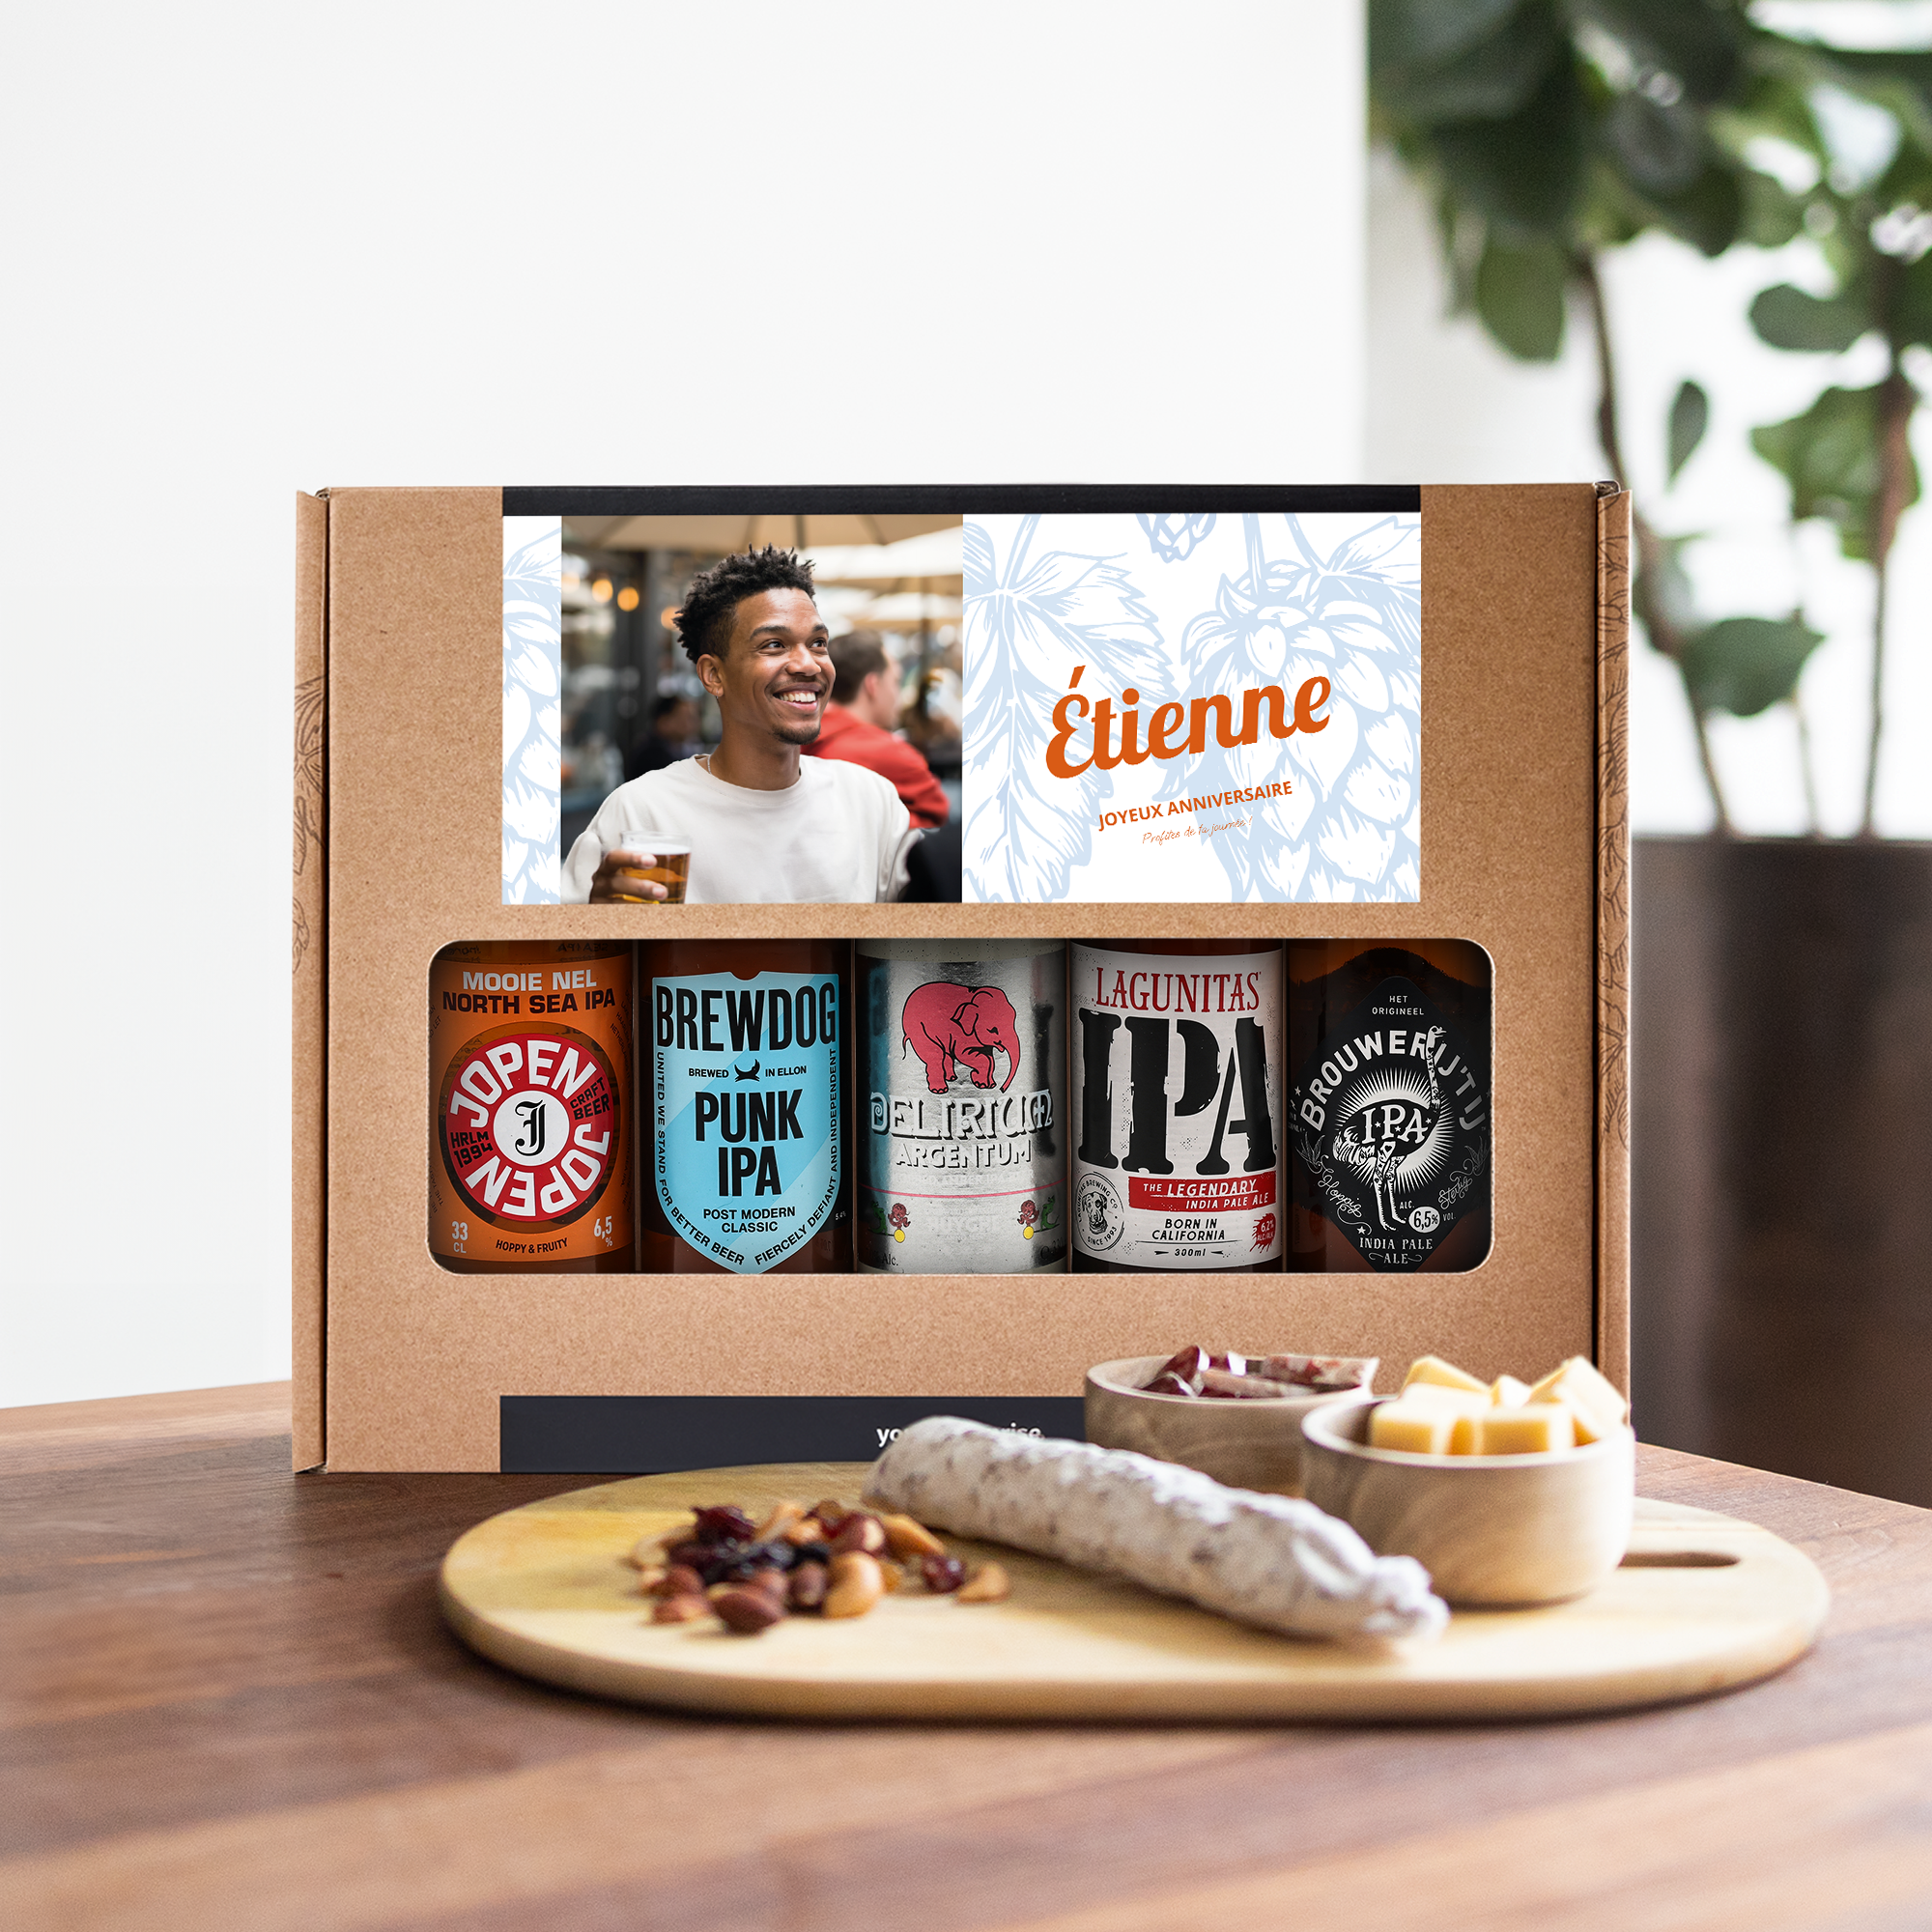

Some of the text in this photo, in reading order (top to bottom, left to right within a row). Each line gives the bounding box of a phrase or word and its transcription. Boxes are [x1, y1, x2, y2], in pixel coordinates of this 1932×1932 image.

[1046, 665, 1331, 779] Étienne
[1098, 781, 1293, 832] JOYEUX ANNIVERSAIRE
[1184, 826, 1196, 837] de
[462, 969, 597, 992] MOOIE NEL
[1095, 967, 1261, 1013] LAGUNITAS
[442, 991, 521, 1014] NORTH
[529, 993, 579, 1013] SEA
[585, 987, 616, 1010] IPA
[1389, 995, 1407, 1004] HET
[656, 981, 837, 1052] BREWDOG
[1372, 1007, 1424, 1016] ORIGINEEL
[689, 1065, 807, 1078] BREWED IN ELLON
[450, 1039, 597, 1128] JOPEN
[570, 1077, 606, 1108] CRAFT
[1078, 1007, 1278, 1176] IPA
[574, 1094, 611, 1121] BEER
[695, 1089, 804, 1143] PUNK
[870, 1089, 1054, 1141] DELIRIUM
[1362, 1104, 1429, 1146] IPA
[450, 1130, 490, 1149] HRLM
[453, 1143, 494, 1168] 1994
[656, 1052, 745, 1265] UNITED WE STAND FOR BETTER BEER
[754, 1228, 808, 1265] FIERCELY
[807, 1178, 838, 1227] DEFIANT
[829, 1048, 838, 1141] INDEPENDENT
[895, 1140, 1033, 1168] ARGENTUM
[465, 1122, 611, 1216] JOPEN
[718, 1146, 781, 1197] IPA
[1143, 1178, 1258, 1197] THE LEGENDARY
[1318, 1168, 1362, 1218] Hoppig
[1185, 1192, 1268, 1209] INDIA PALE ALE
[1399, 1201, 1415, 1209] ALC.
[703, 1206, 796, 1220] POST MODERN
[1413, 1209, 1438, 1229] 6,5%
[1442, 1212, 1457, 1222] VOL.
[451, 1221, 469, 1240] 33
[593, 1216, 612, 1238] 6,5
[721, 1220, 779, 1233] CLASSIC
[1164, 1218, 1217, 1230] BORN IN
[496, 1237, 568, 1254] HOPPY & FRUITY
[1088, 1236, 1103, 1246] SINCE
[1151, 1230, 1226, 1241] CALIFORNIA
[1359, 1236, 1433, 1250] INDIA PALE
[453, 1241, 467, 1254] CL
[1175, 1248, 1207, 1258] 300ml
[1383, 1253, 1408, 1264] ALE
